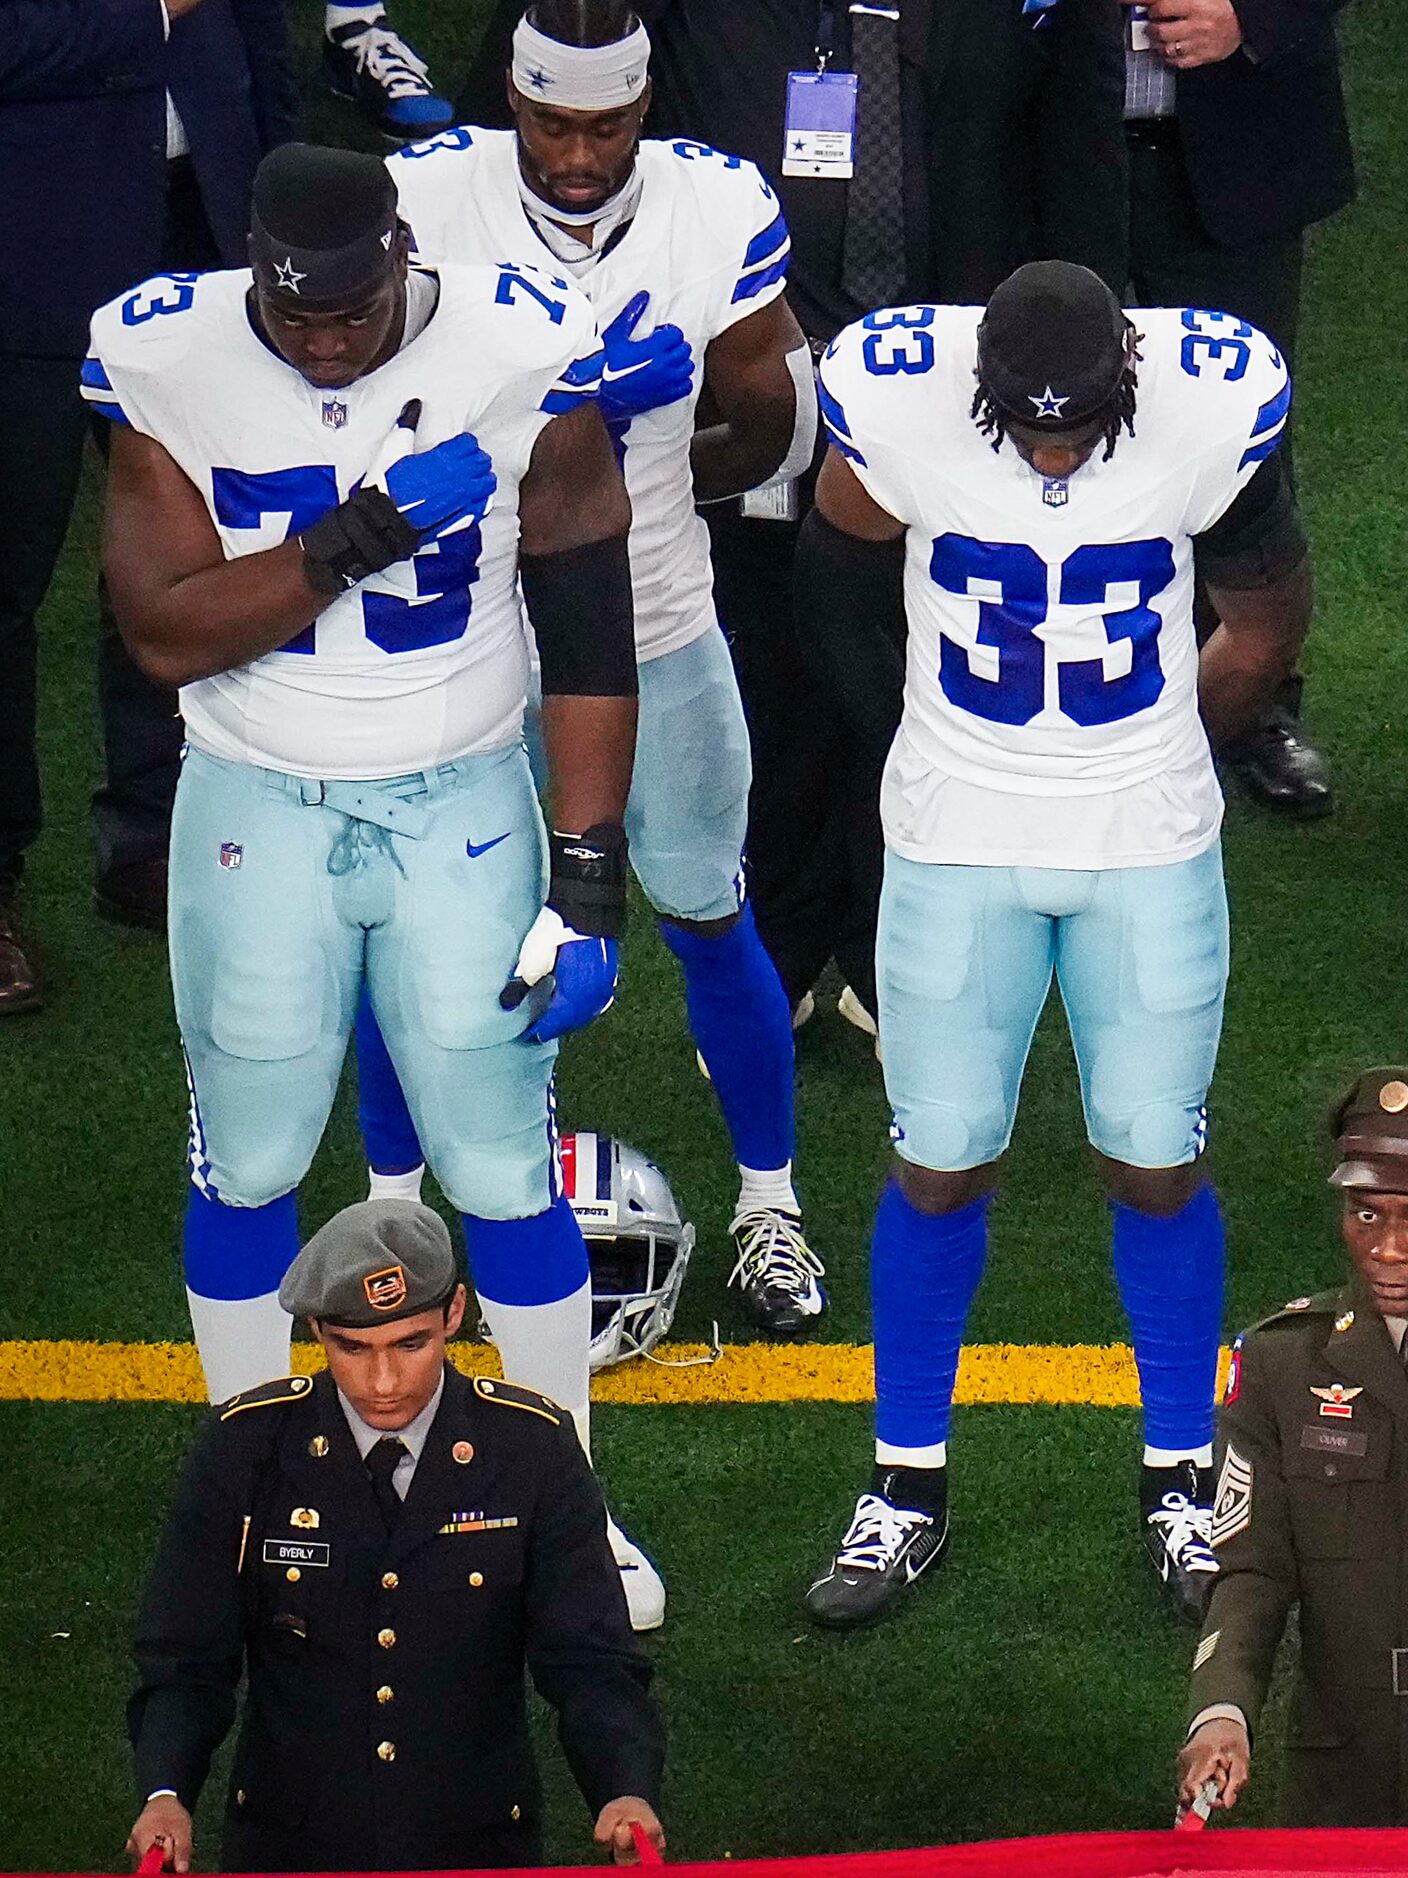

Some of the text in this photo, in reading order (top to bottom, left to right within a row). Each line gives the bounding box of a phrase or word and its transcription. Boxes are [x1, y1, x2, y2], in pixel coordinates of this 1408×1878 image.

[494, 262, 568, 326] 7
[863, 306, 936, 376] 33
[1180, 308, 1252, 382] 33
[211, 465, 483, 655] 73
[929, 532, 1177, 727] 33
[573, 1206, 610, 1217] WBOYS
[279, 1546, 314, 1560] BYERLY
